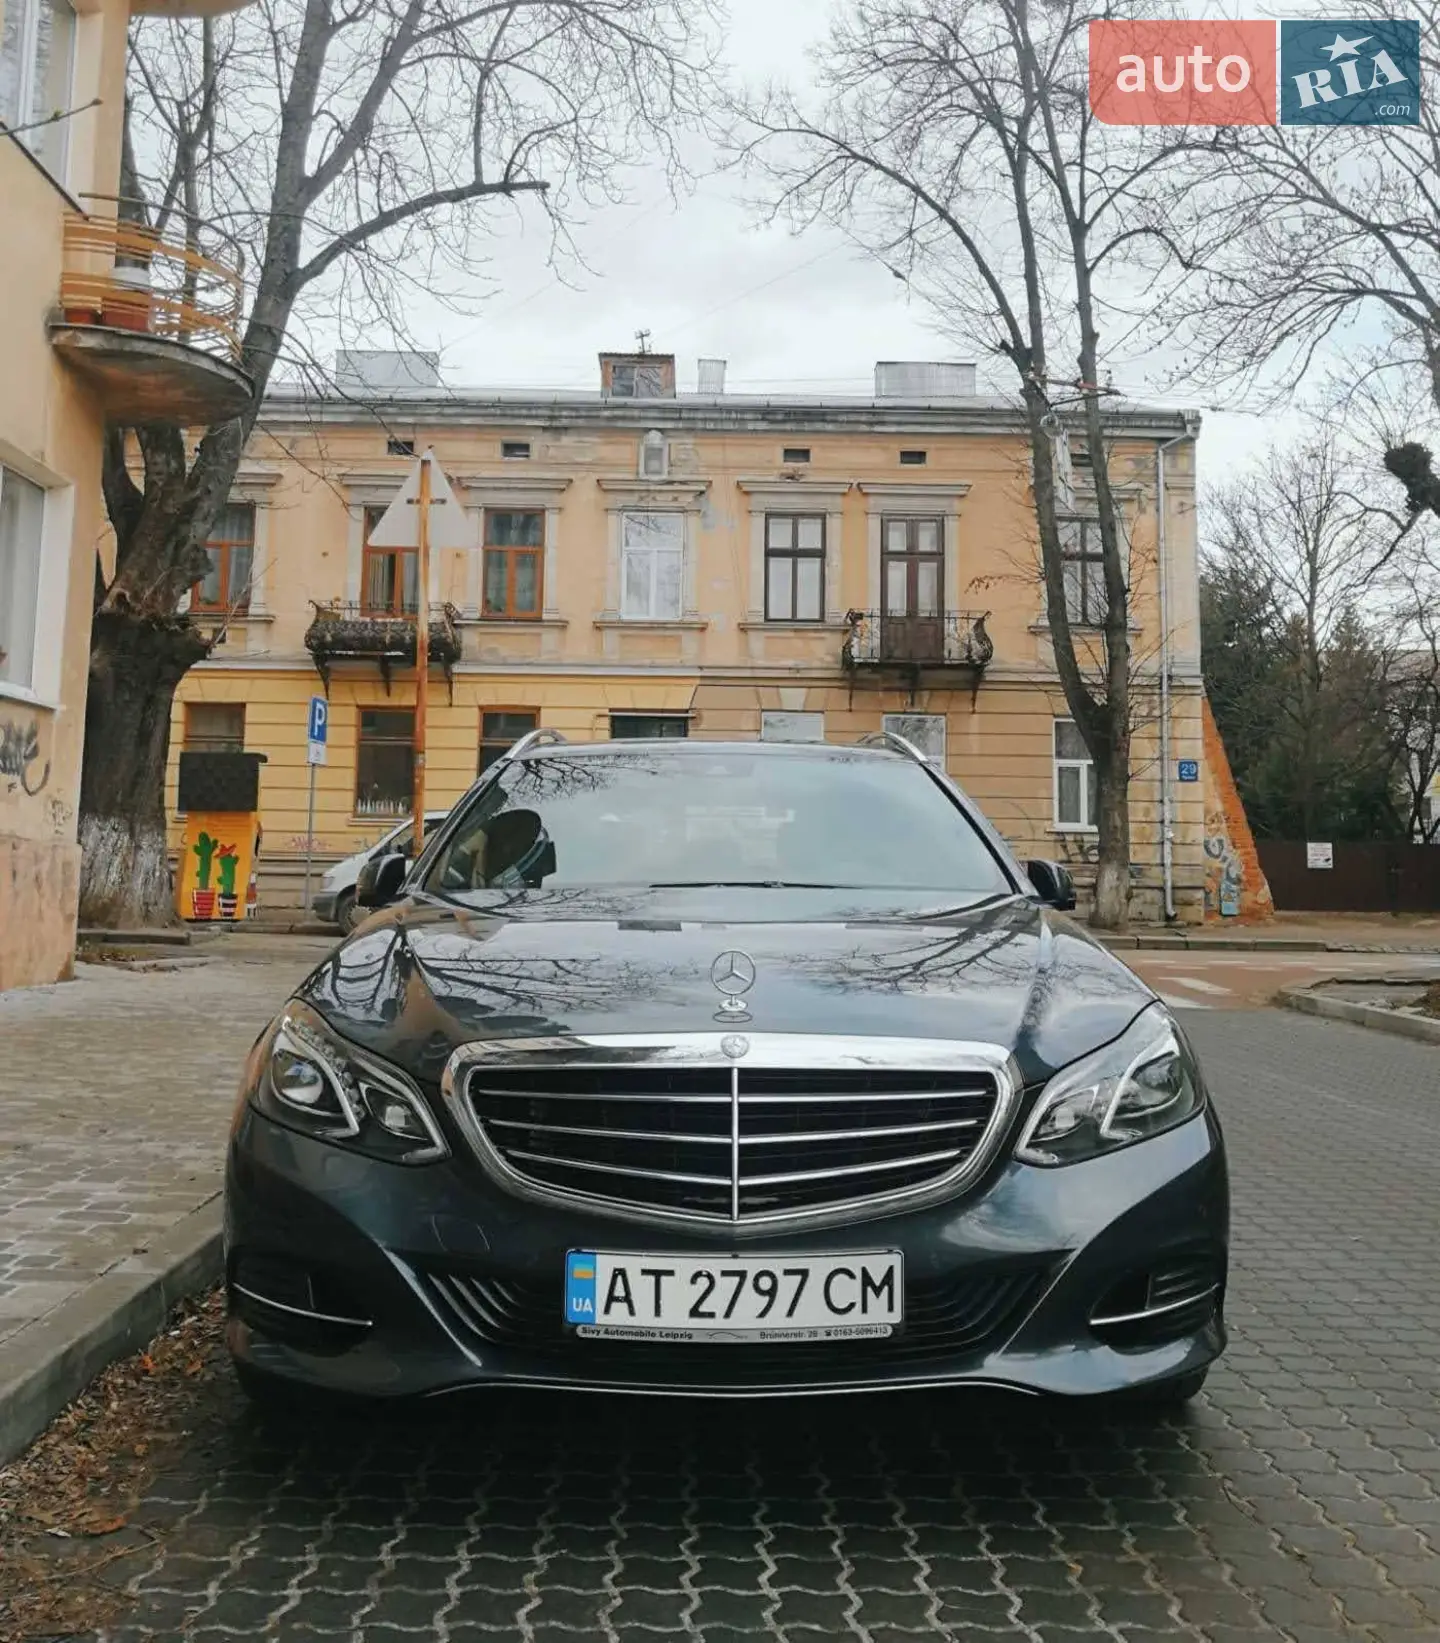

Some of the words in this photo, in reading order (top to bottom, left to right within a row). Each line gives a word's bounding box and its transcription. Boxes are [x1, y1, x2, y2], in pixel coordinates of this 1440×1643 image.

[314, 701, 326, 736] P
[1180, 763, 1197, 775] 29
[603, 1267, 675, 1318] AT
[689, 1268, 810, 1319] 2797
[823, 1264, 895, 1316] CM
[572, 1297, 593, 1313] UA
[603, 1328, 657, 1338] Automobile
[659, 1330, 693, 1340] Leipzig
